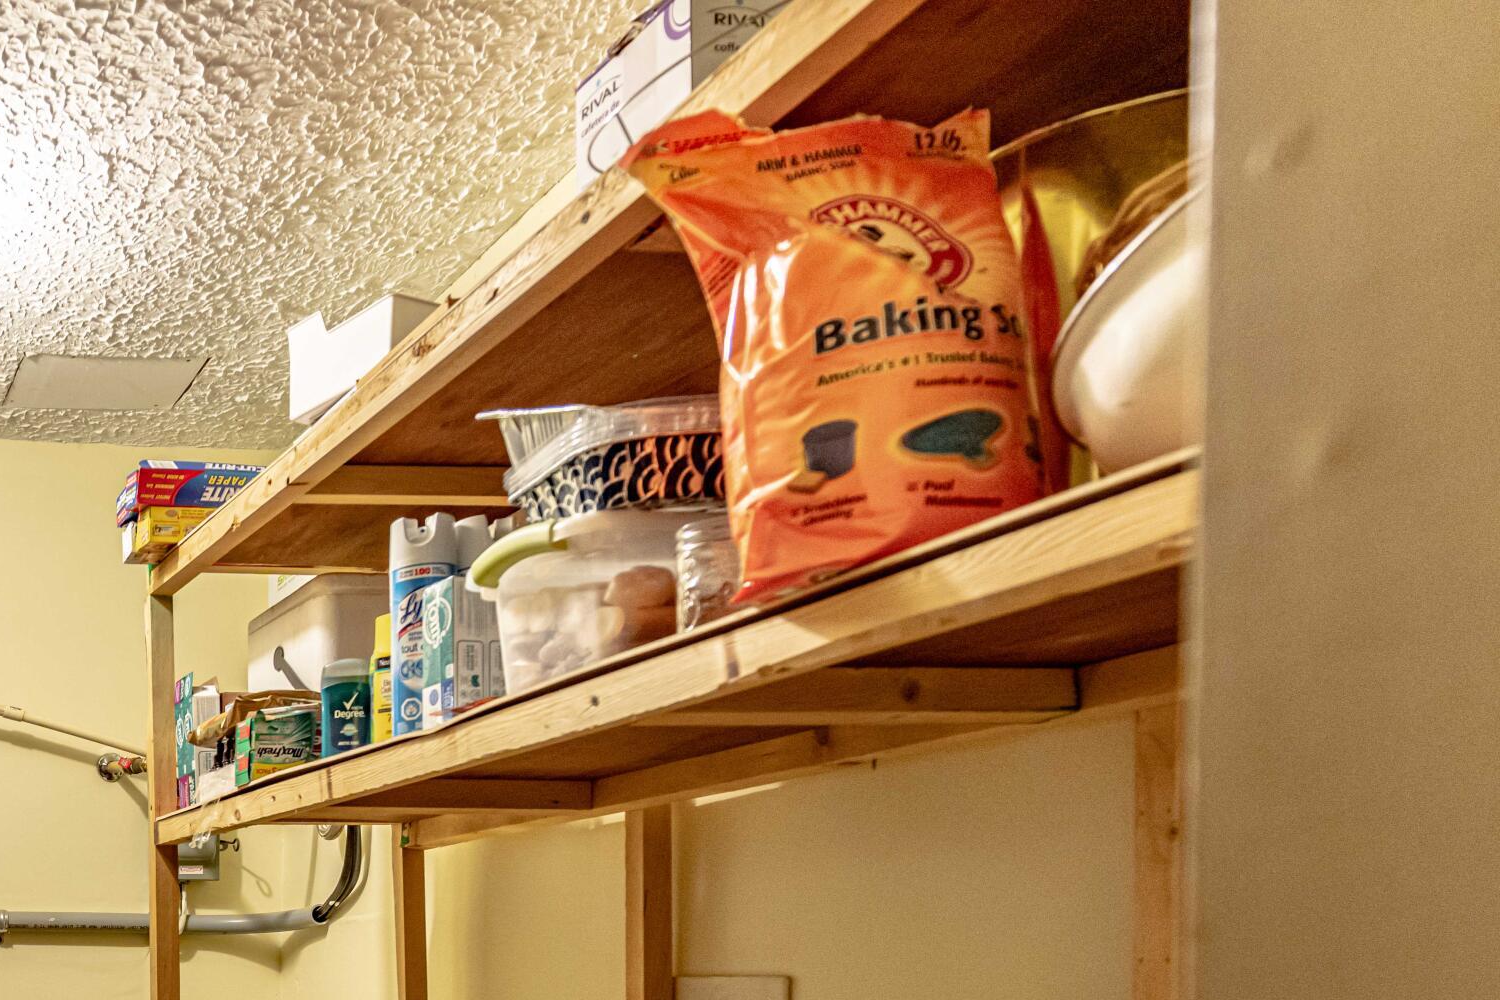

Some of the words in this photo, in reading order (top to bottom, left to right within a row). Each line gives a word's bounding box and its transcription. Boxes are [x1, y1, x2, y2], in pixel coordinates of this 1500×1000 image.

[581, 81, 620, 121] RIVAL
[814, 295, 985, 356] Baking
[208, 475, 247, 486] PAPER
[200, 486, 242, 502] RITE
[334, 710, 365, 719] Degree
